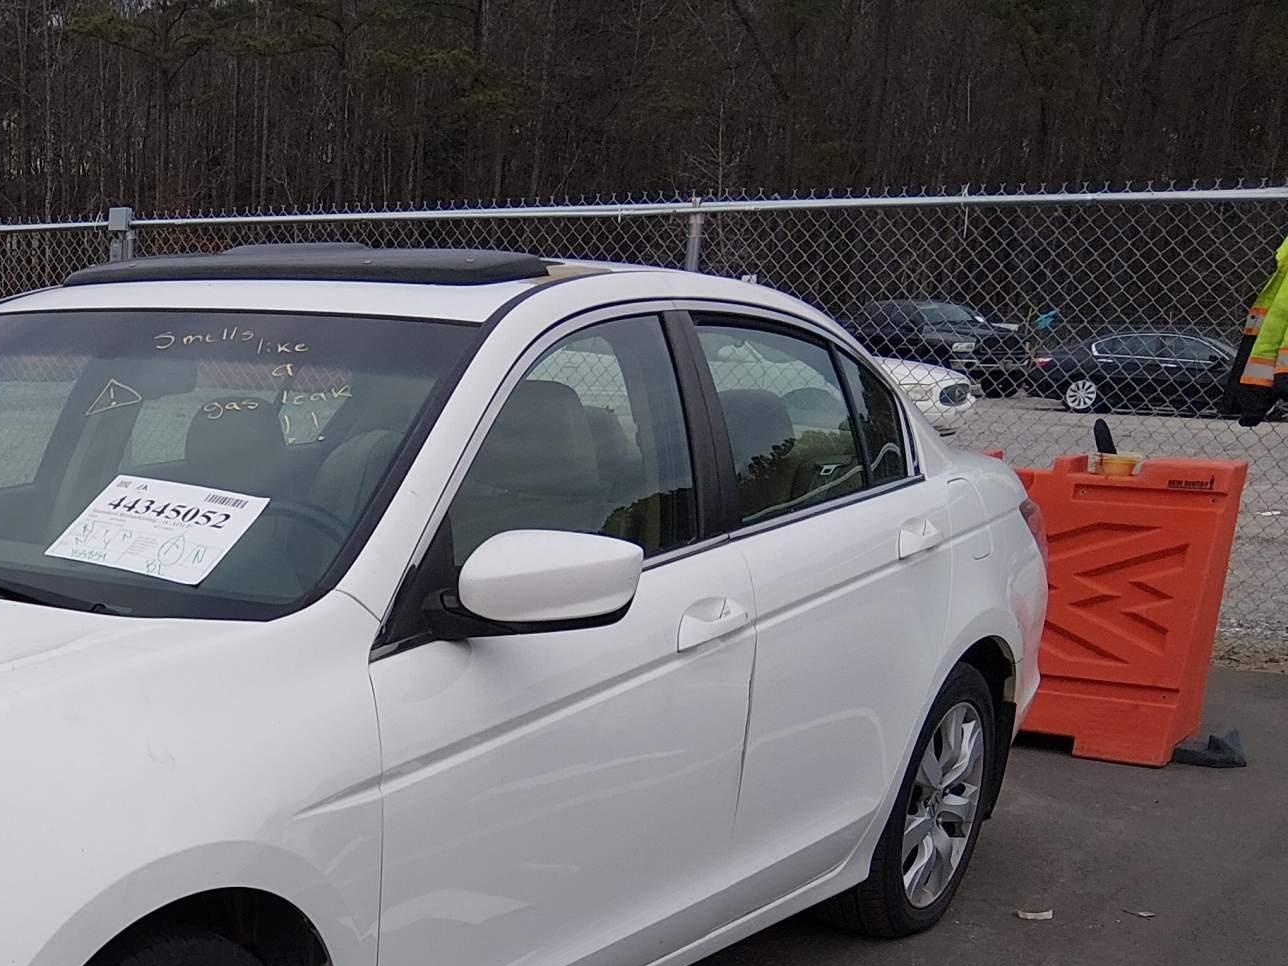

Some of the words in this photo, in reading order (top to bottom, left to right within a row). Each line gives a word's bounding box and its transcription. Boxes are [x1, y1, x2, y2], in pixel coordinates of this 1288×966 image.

[257, 337, 310, 354] like
[202, 398, 259, 419] gas
[283, 385, 353, 404] leak
[108, 496, 231, 528] 44345052
